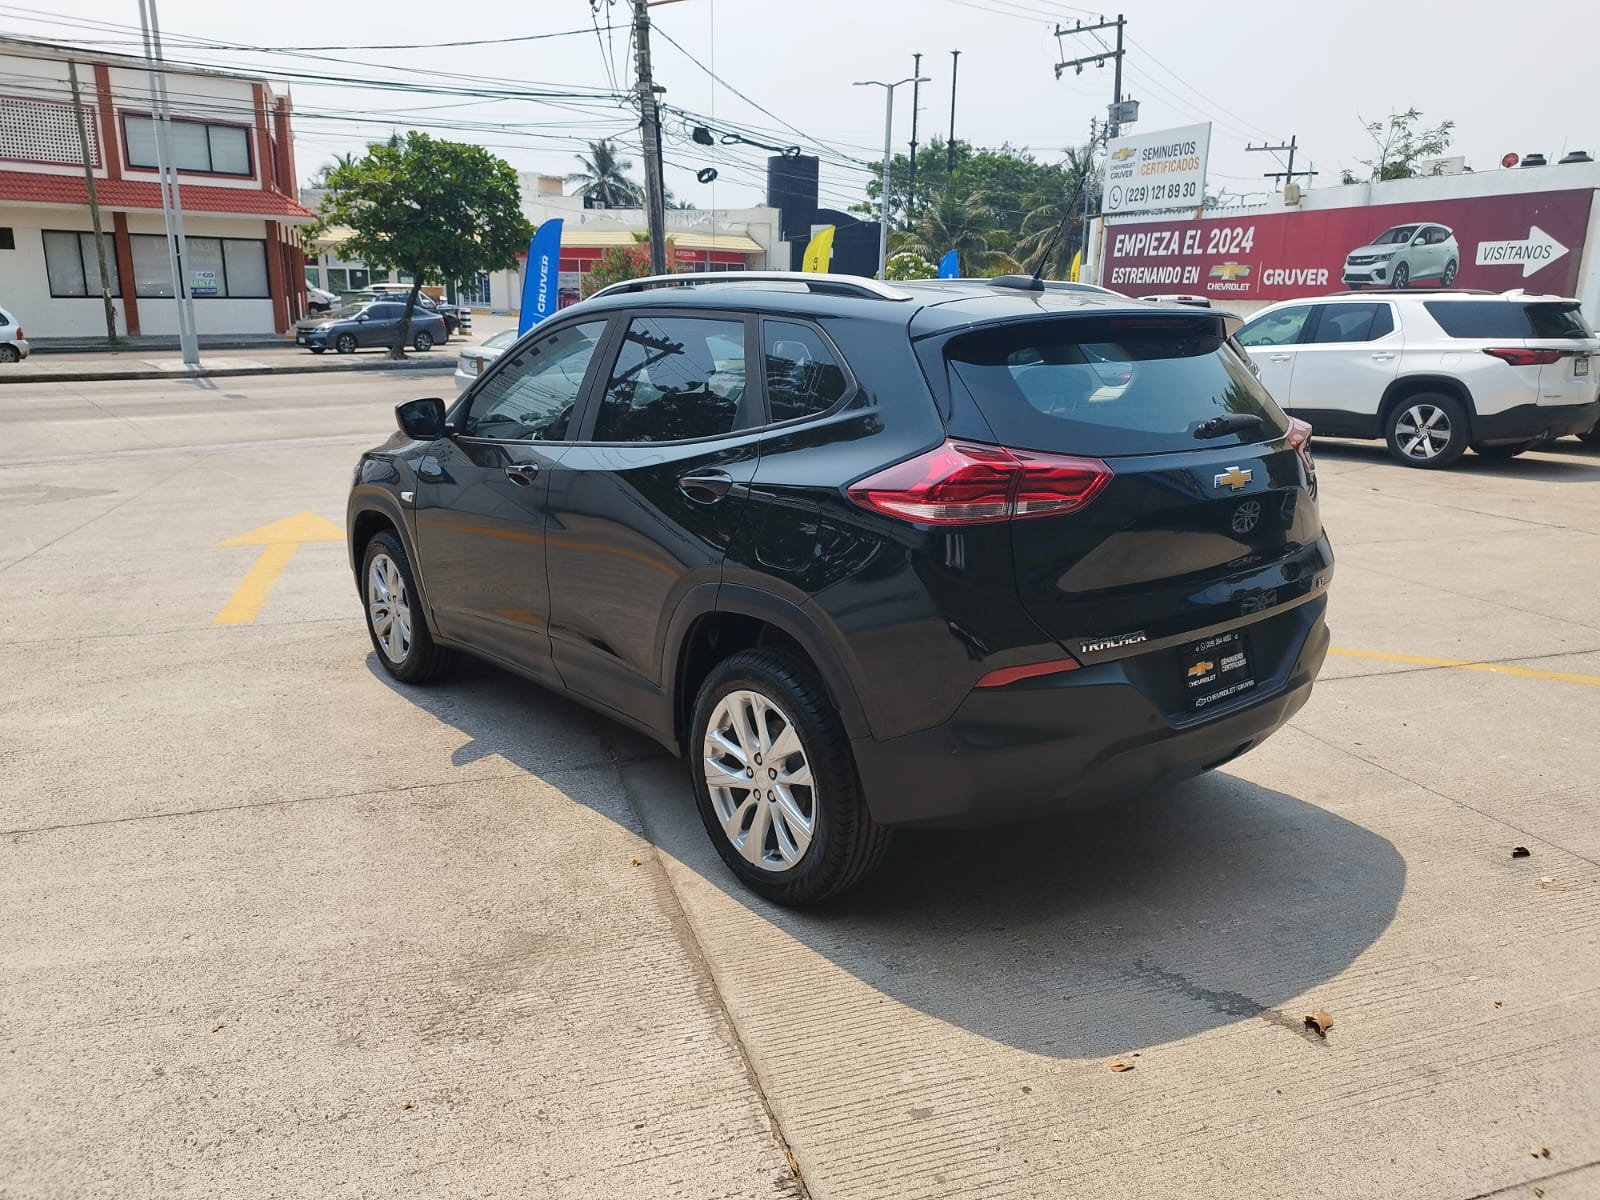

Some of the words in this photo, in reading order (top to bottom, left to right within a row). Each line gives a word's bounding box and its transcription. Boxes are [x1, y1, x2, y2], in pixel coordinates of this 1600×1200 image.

[1142, 141, 1196, 161] SEMINUEVOS
[1110, 162, 1136, 171] CHEVROLET
[1110, 170, 1133, 179] GRUVER
[1141, 157, 1200, 176] CERTIFICADOS
[1125, 184, 1149, 206] (229)
[1151, 185, 1165, 200] 121
[1167, 183, 1181, 199] 89
[1182, 181, 1196, 197] 30
[1113, 231, 1179, 257] EMPIEZA
[1183, 230, 1203, 255] EL
[1207, 226, 1255, 255] 2024
[1483, 242, 1552, 260] VISÍTANOS
[537, 255, 549, 313] GRUVER
[1111, 267, 1181, 284] ESTRENANDO
[1183, 266, 1200, 283] EN
[1263, 268, 1329, 286] GRUVER
[1207, 282, 1251, 291] CHEVROLET
[1080, 630, 1147, 653] TRACKER
[1188, 674, 1216, 688] CHEVROLET
[1206, 686, 1236, 702] CHEVROLET
